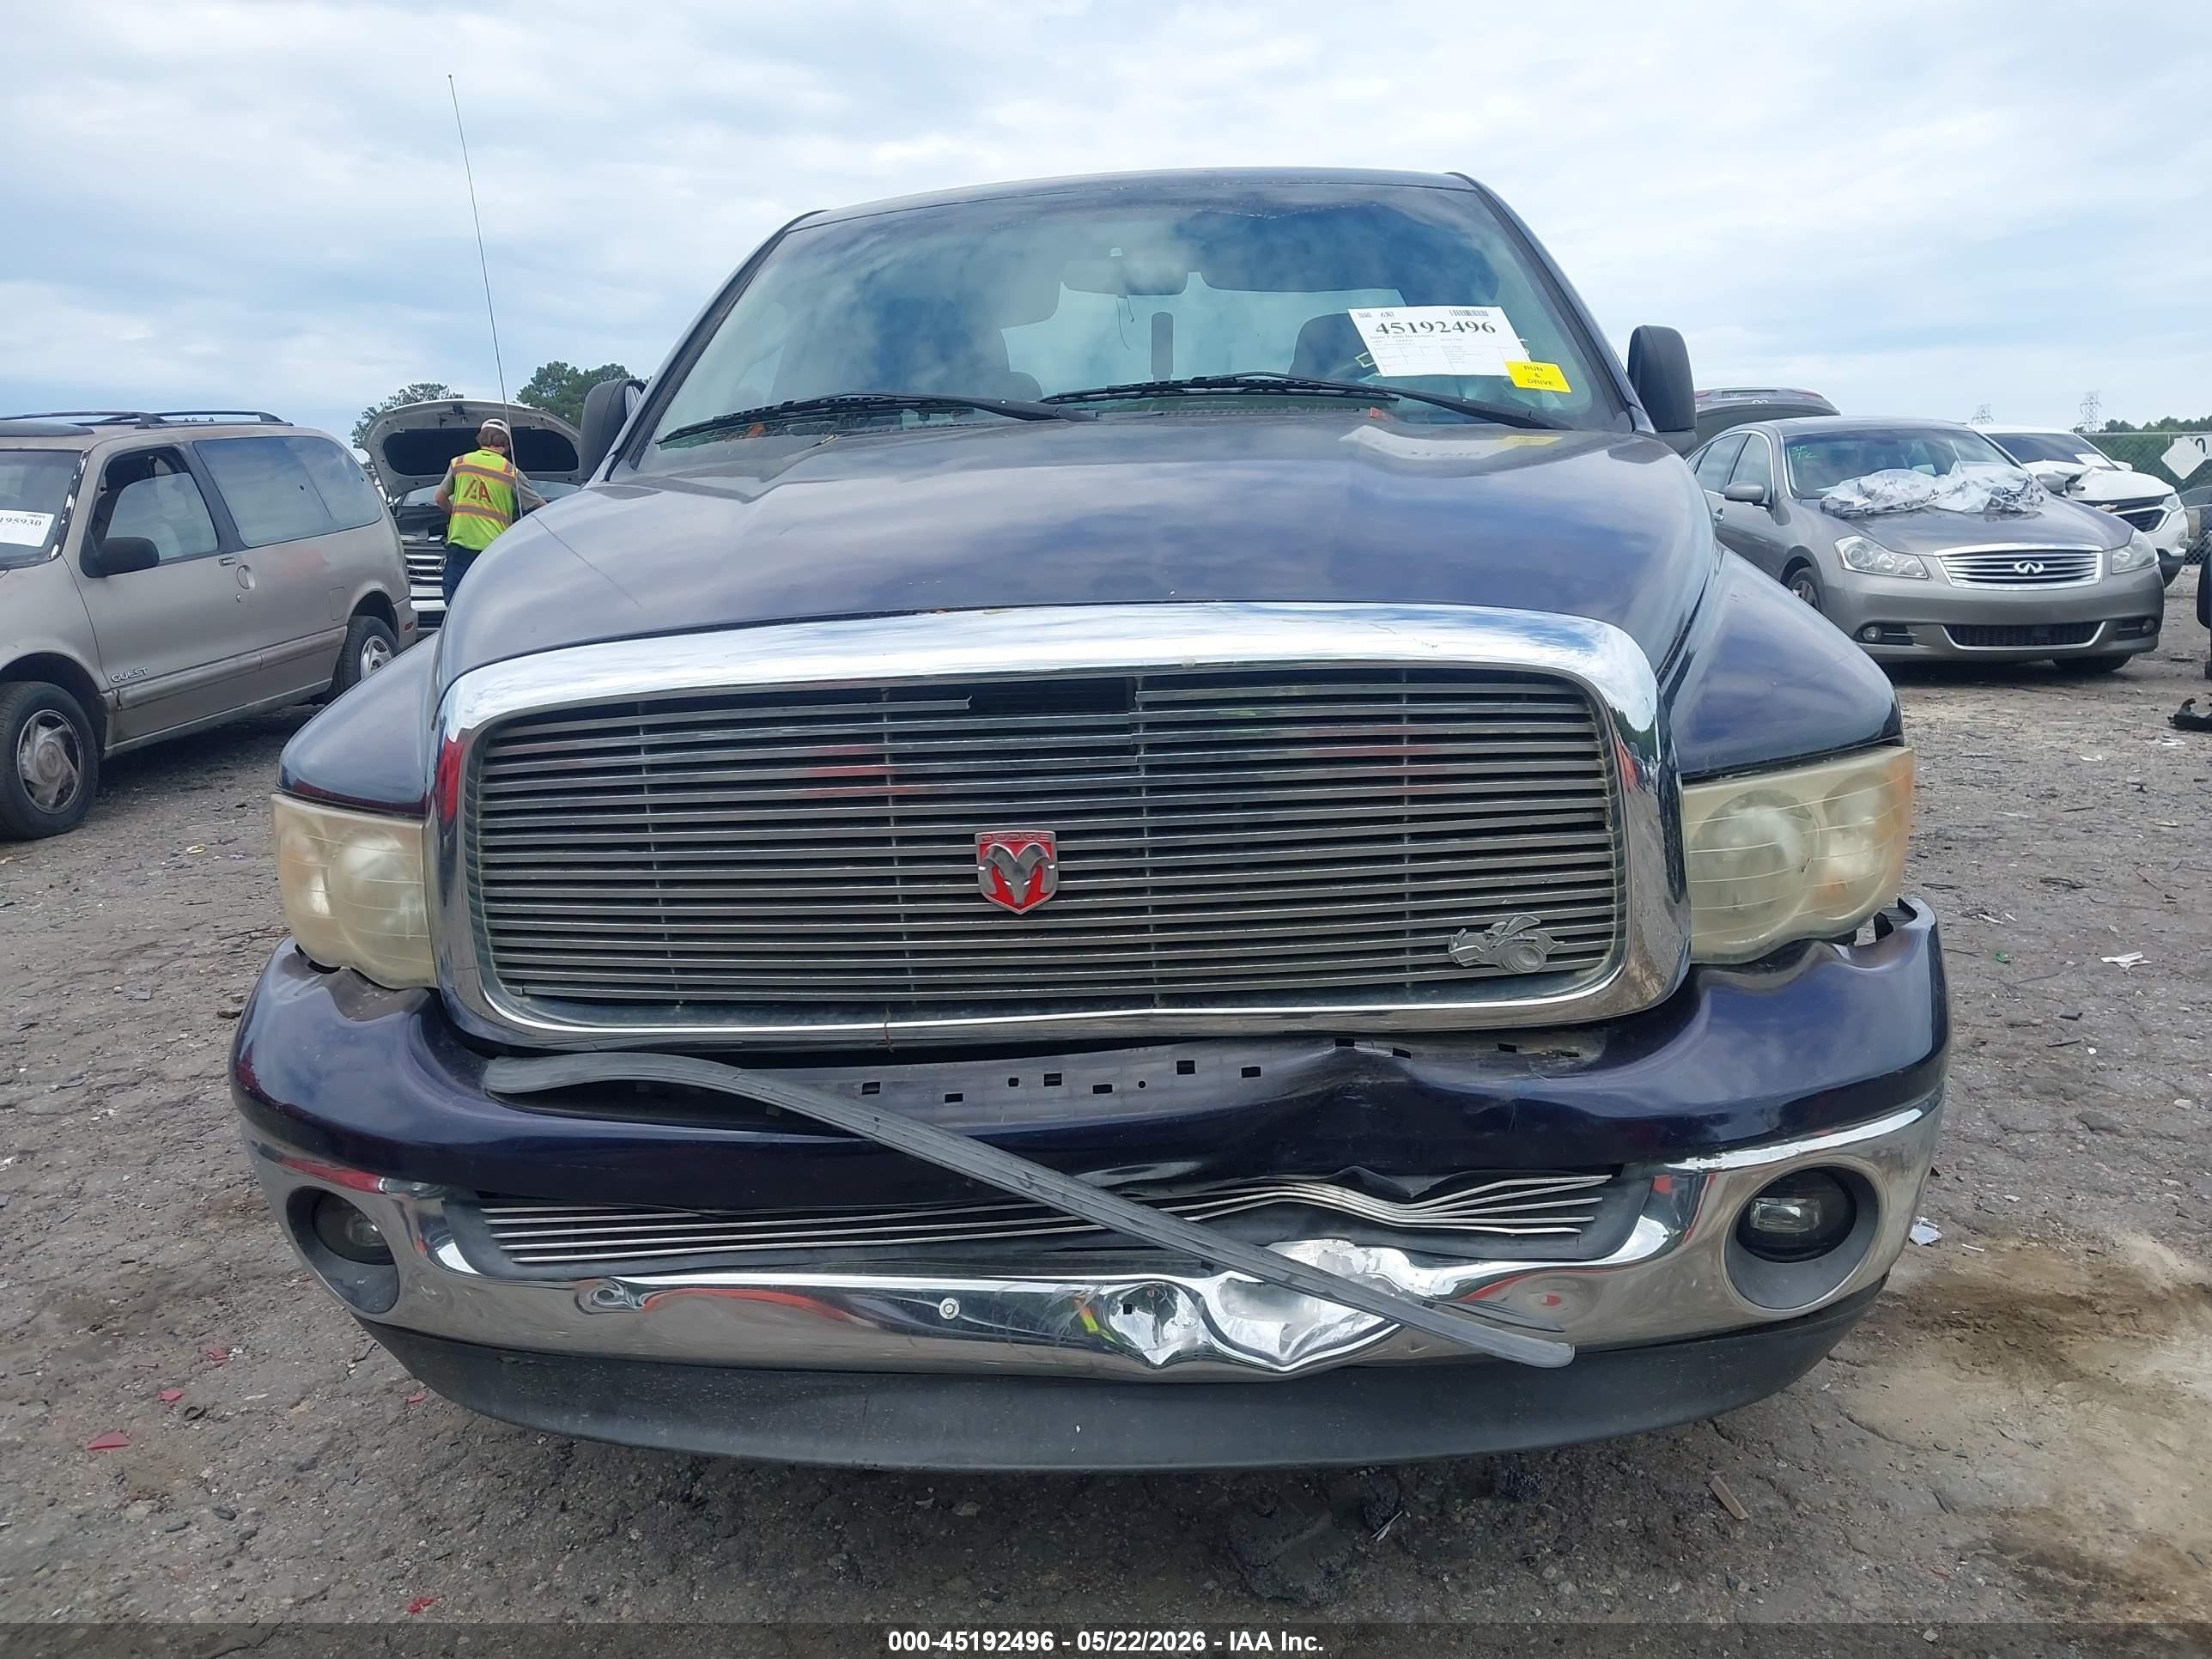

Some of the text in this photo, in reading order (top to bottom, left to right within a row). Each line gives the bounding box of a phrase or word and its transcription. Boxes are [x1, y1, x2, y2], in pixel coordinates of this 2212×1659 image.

[1376, 321, 1496, 334] 45192496
[111, 666, 148, 683] QUEST
[981, 834, 1051, 844] DODGE
